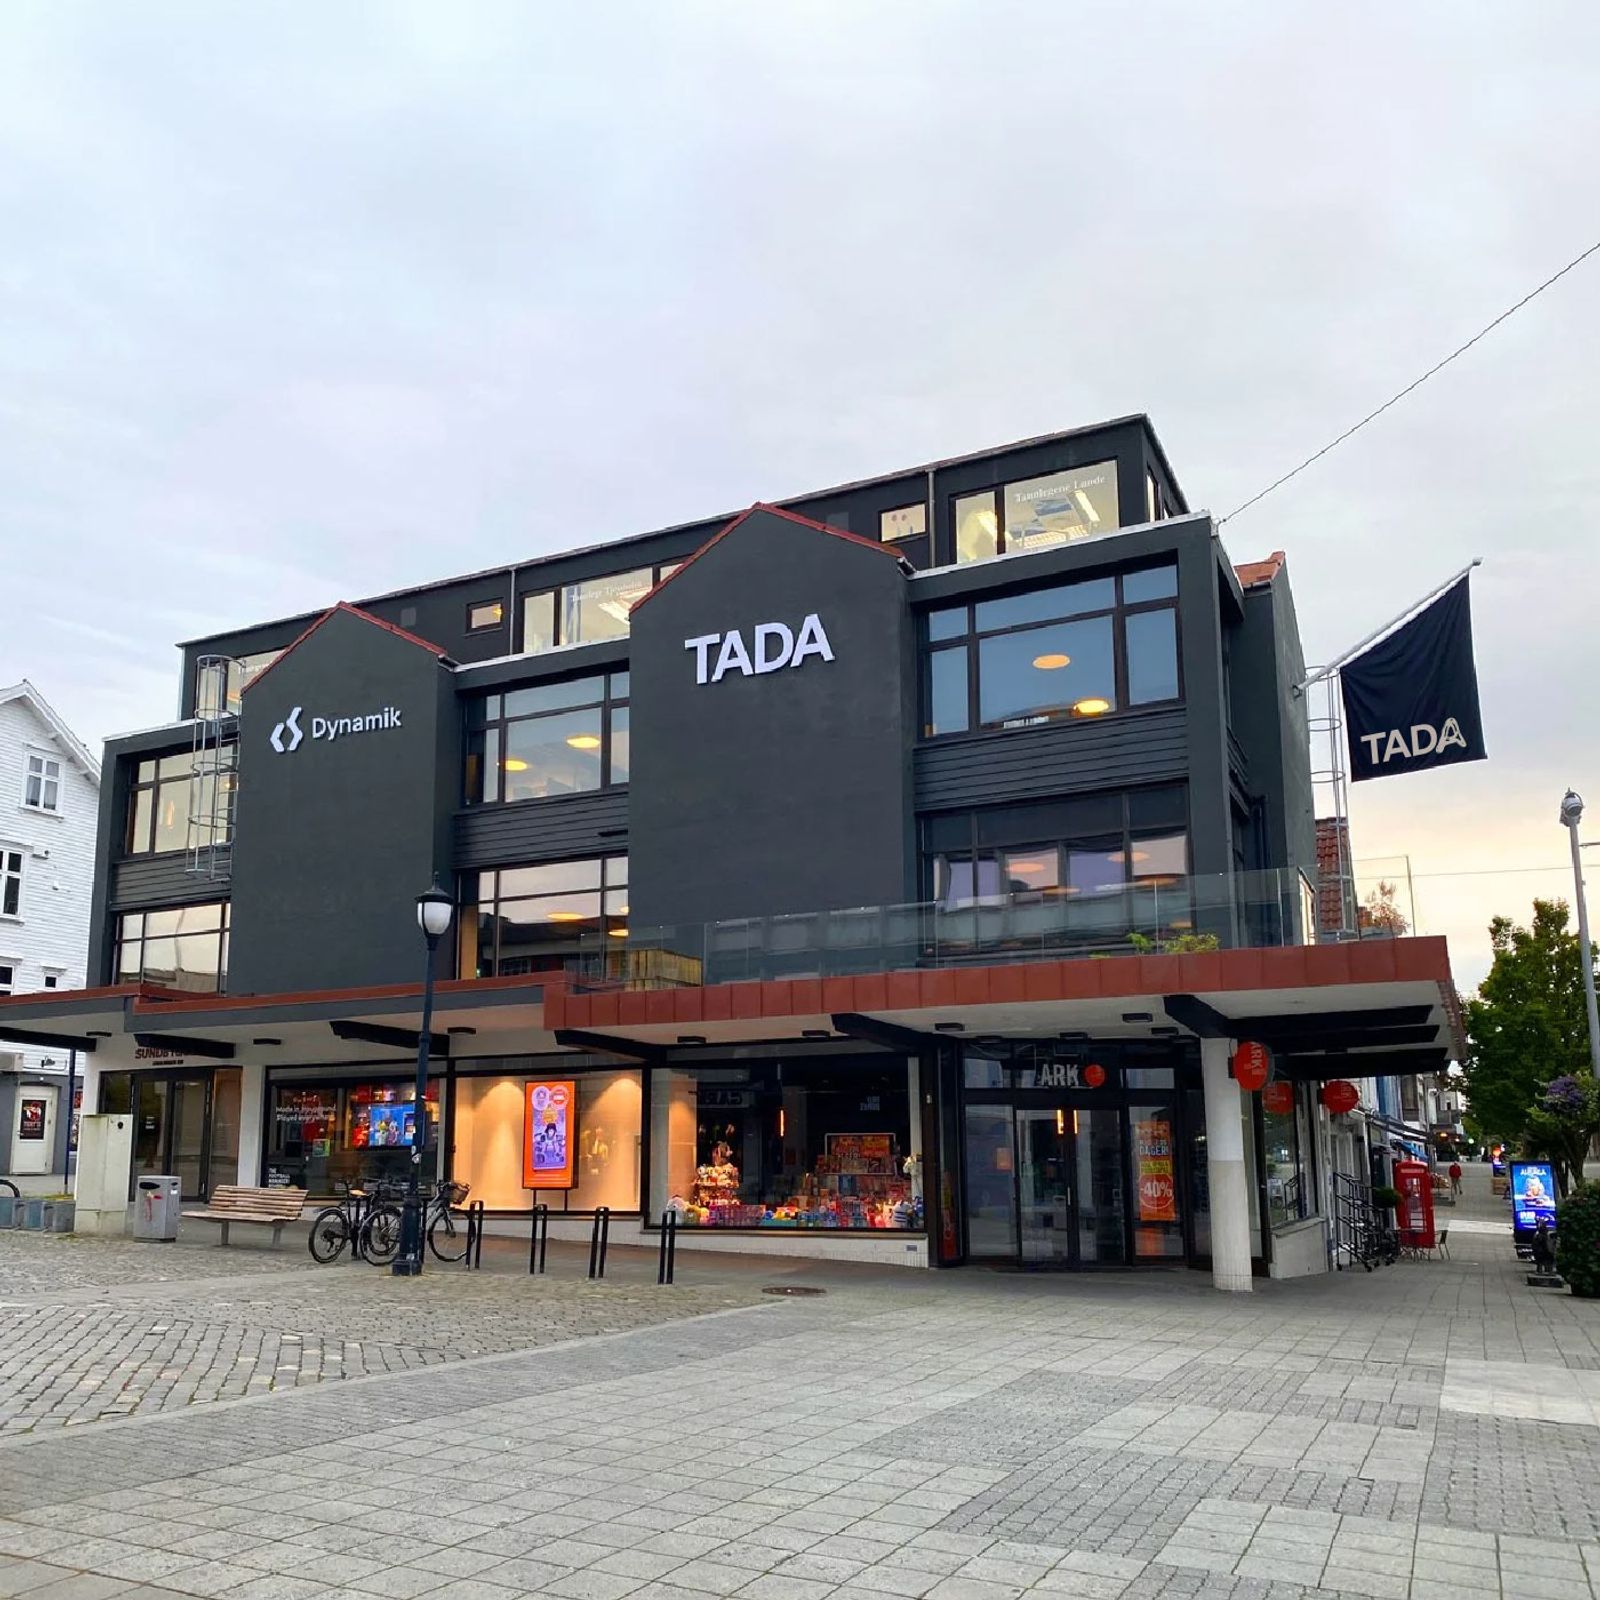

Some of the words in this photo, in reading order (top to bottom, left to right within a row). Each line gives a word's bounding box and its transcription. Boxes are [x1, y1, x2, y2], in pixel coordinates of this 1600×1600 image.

[1015, 484, 1071, 502] Tannlegene
[1074, 475, 1105, 490] Lunde
[684, 613, 836, 685] TADA
[312, 706, 402, 740] Dynamik
[1360, 717, 1467, 765] TADA
[1041, 1063, 1079, 1087] ARK
[1140, 1181, 1173, 1198] -40%
